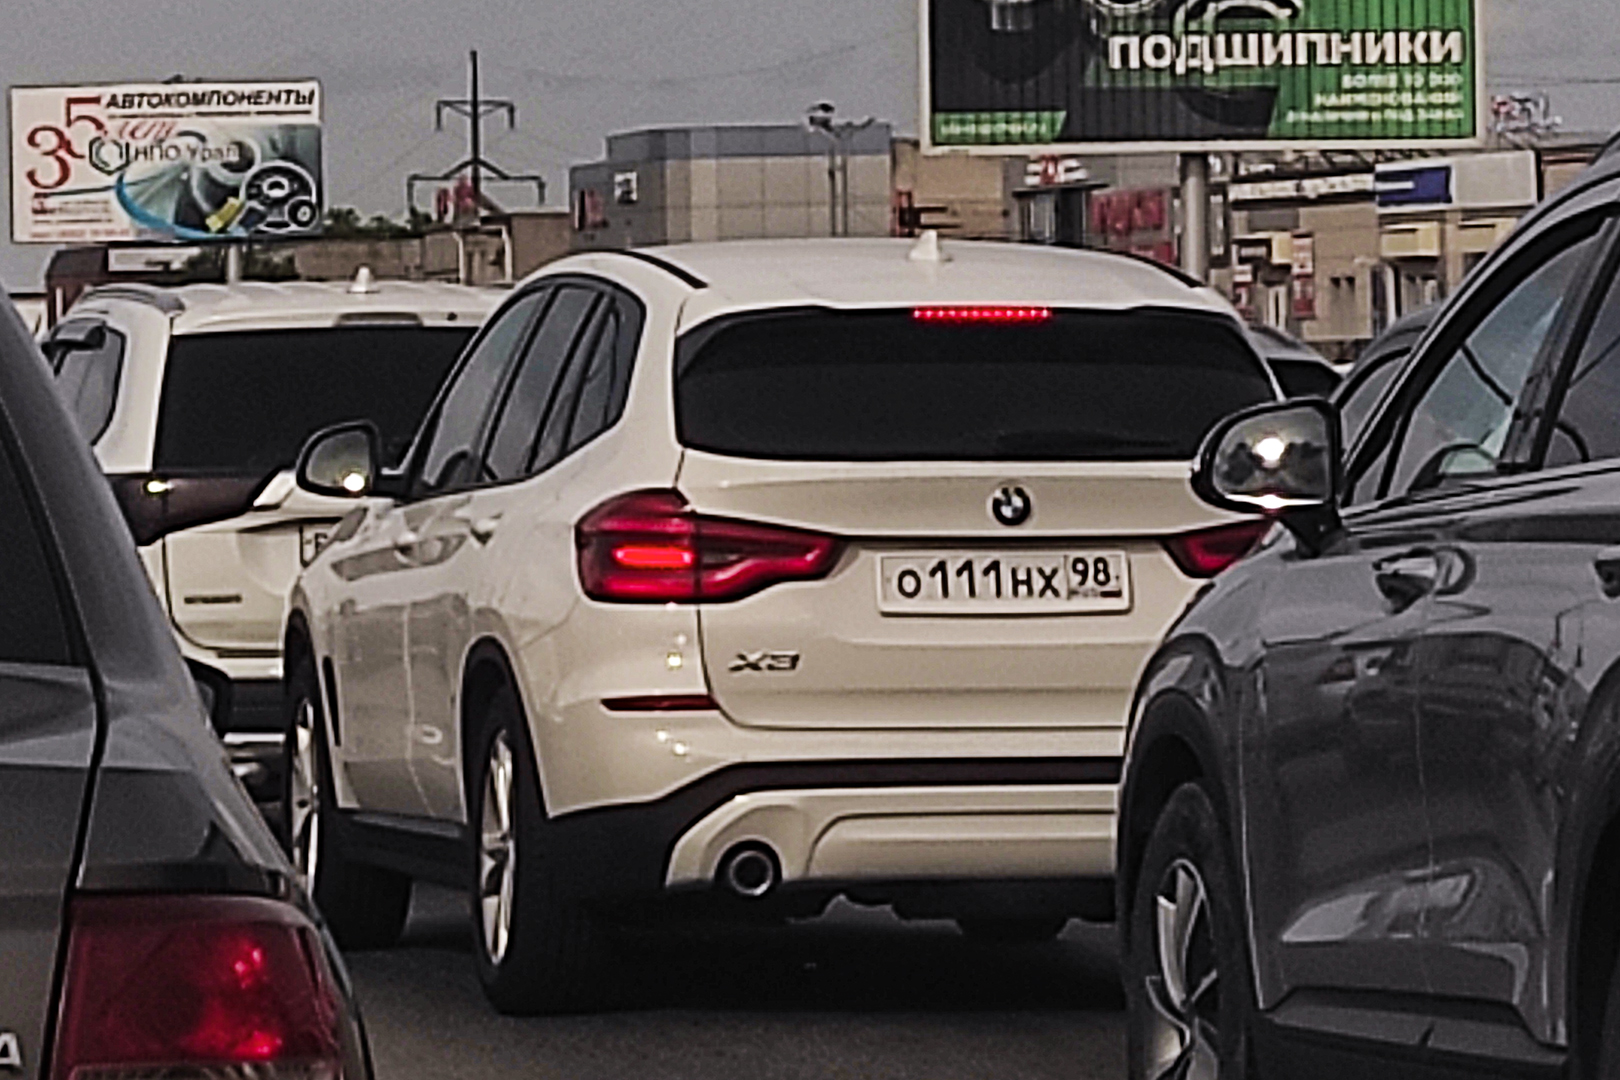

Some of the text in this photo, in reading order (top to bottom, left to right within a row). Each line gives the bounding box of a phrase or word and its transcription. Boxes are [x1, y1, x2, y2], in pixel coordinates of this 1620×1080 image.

[1107, 30, 1463, 75] ПОДШИПНИКИ
[105, 89, 315, 109] АВТОКОМПОНЕНТЫ
[134, 144, 181, 161] НПО
[1072, 556, 1111, 587] 98
[728, 653, 800, 672] X3
